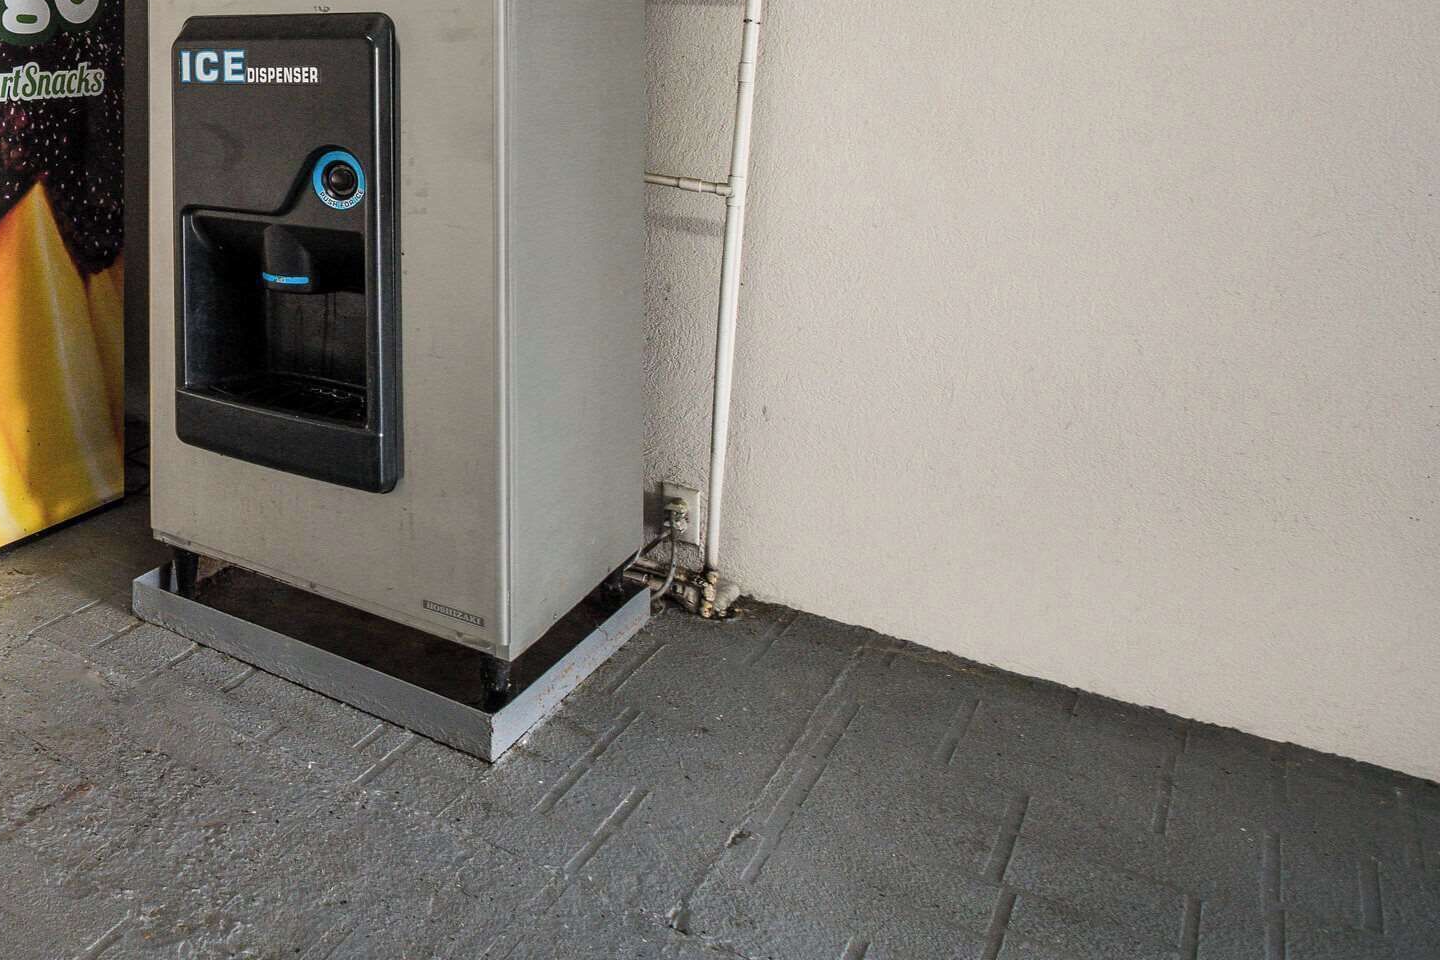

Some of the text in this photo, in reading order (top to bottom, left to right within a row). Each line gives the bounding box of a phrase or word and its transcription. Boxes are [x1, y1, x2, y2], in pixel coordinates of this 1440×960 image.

[180, 49, 319, 83] ICE DISPENSER
[319, 191, 338, 208] PUSH
[426, 601, 481, 624] HOSHIZAKI
